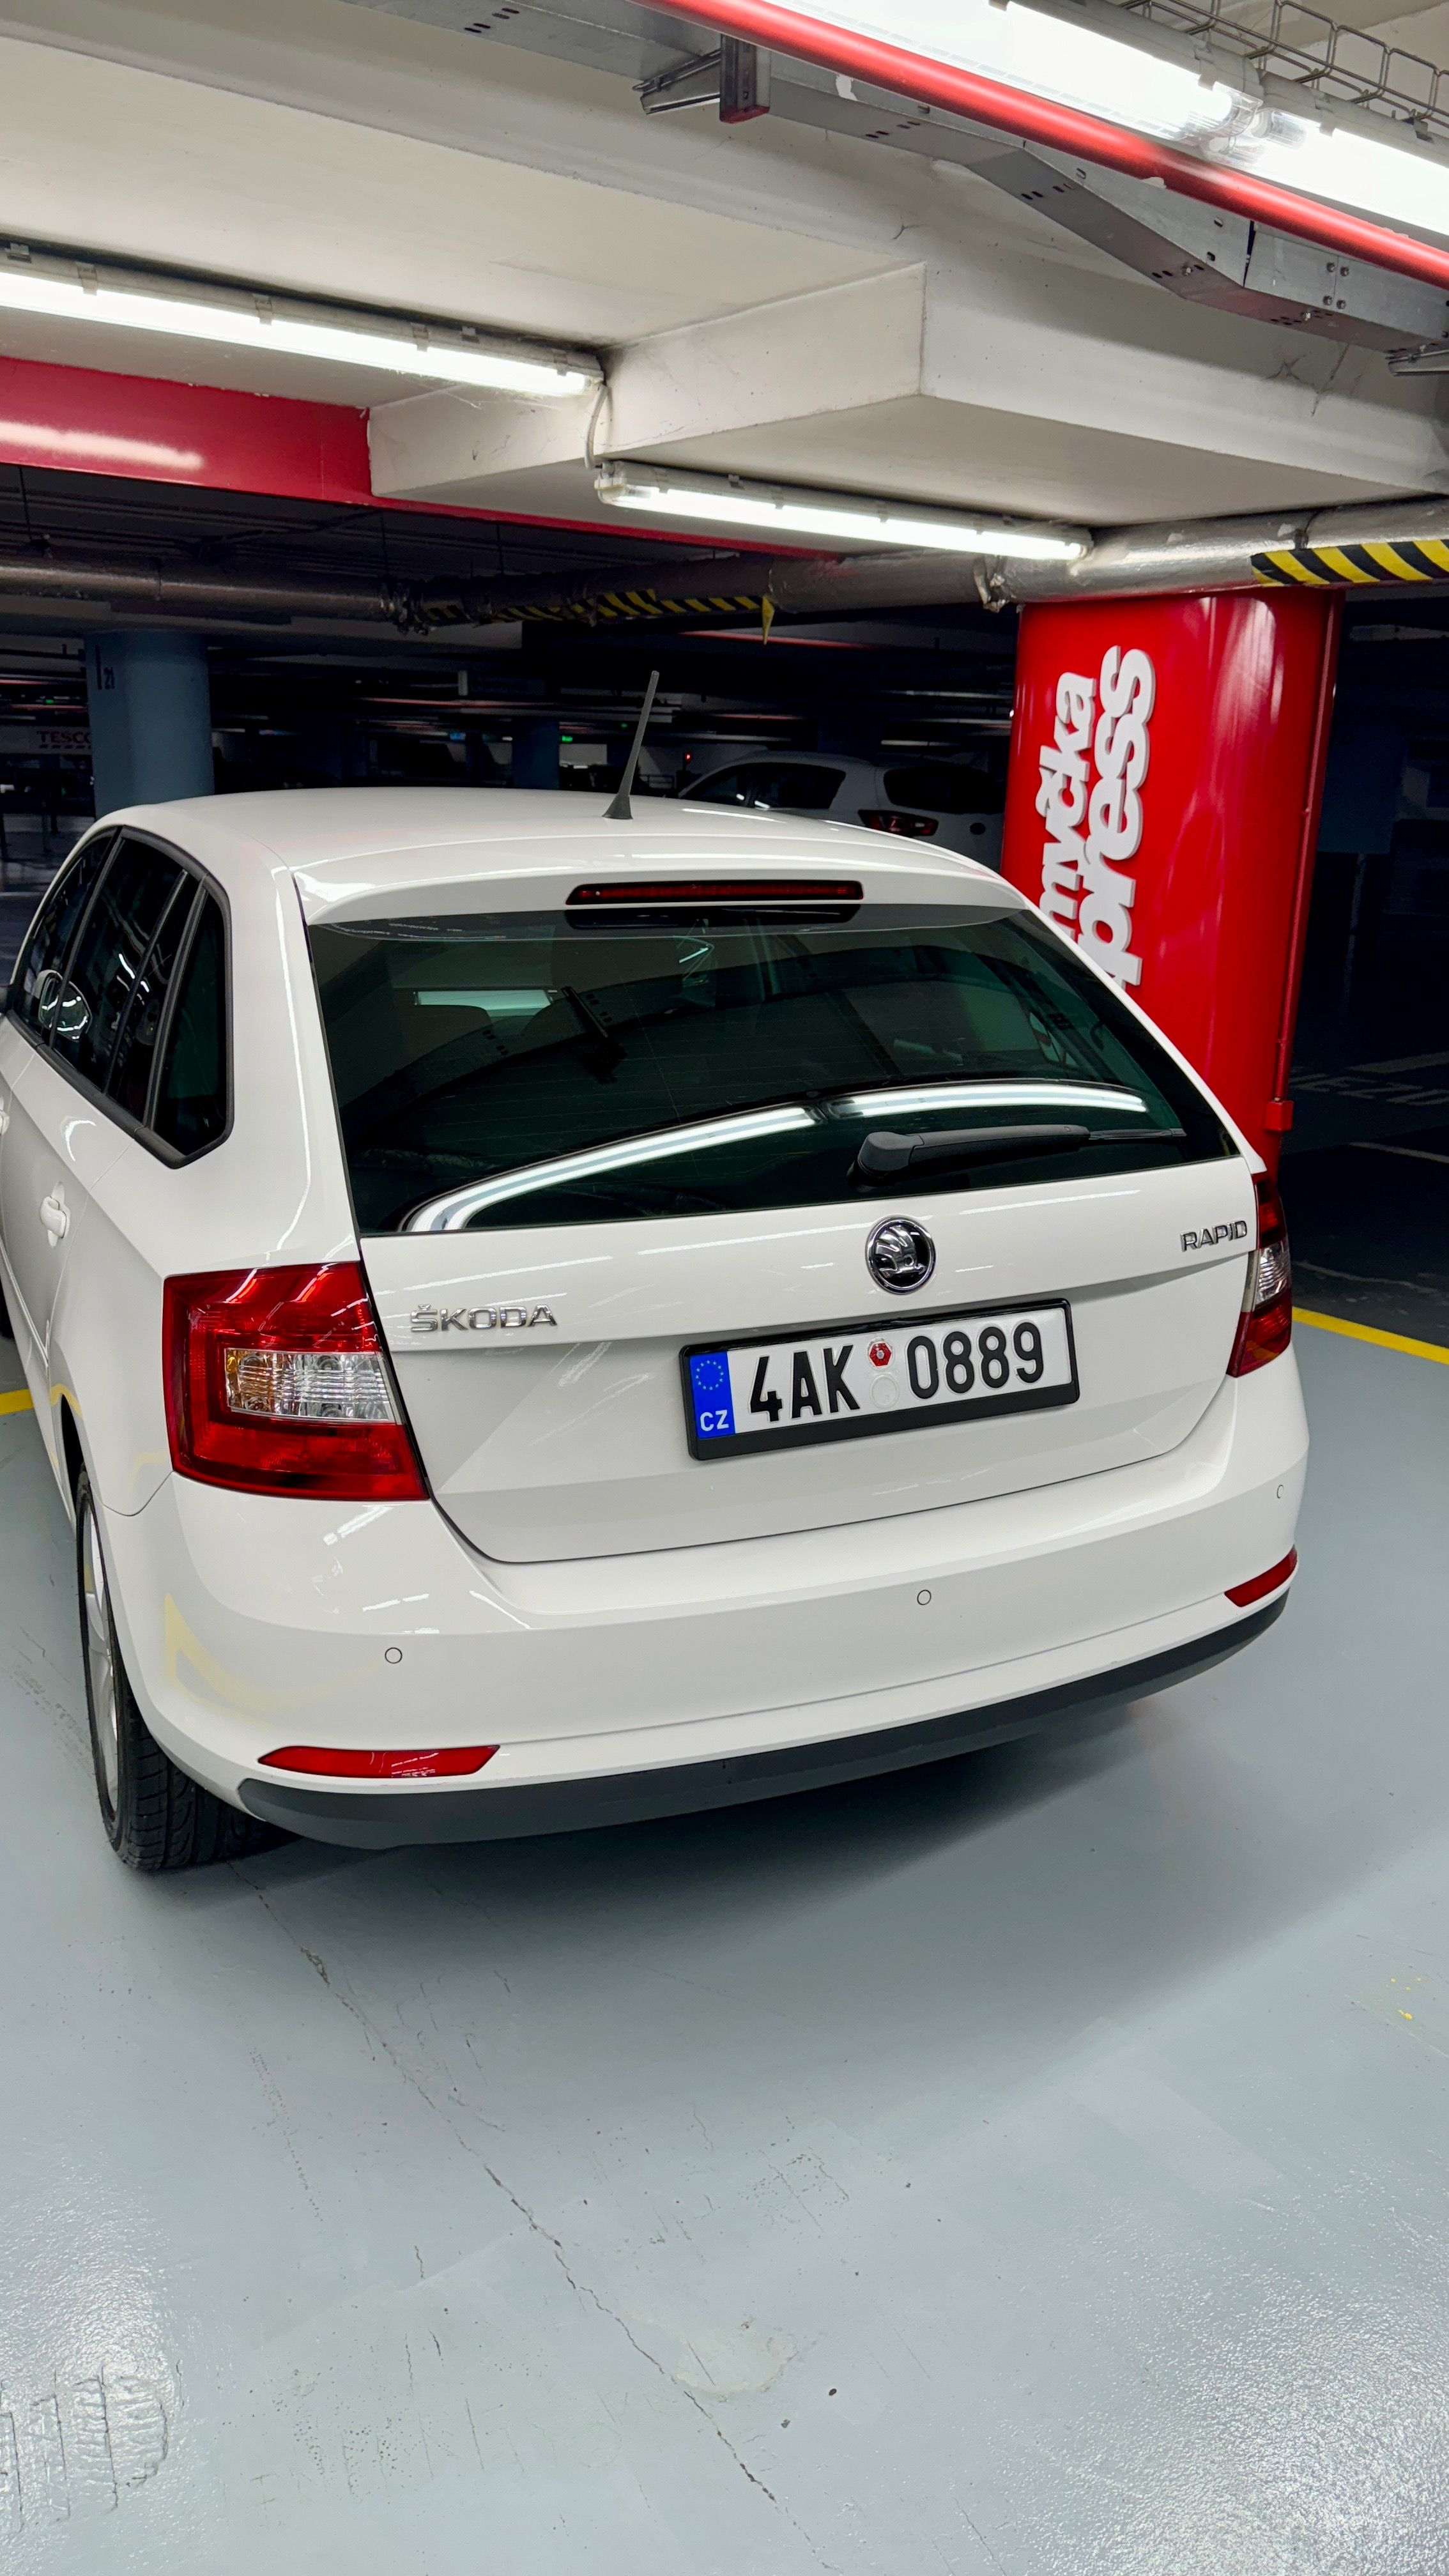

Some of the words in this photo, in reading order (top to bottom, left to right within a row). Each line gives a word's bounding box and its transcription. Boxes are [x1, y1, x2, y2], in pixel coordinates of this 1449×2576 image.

[1078, 645, 1156, 989] press
[1180, 1220, 1248, 1252] RAPID
[411, 1303, 558, 1333] ŠKODA
[749, 1344, 861, 1423] 4AK
[905, 1321, 1045, 1400] 0889
[699, 1408, 730, 1432] CZ
